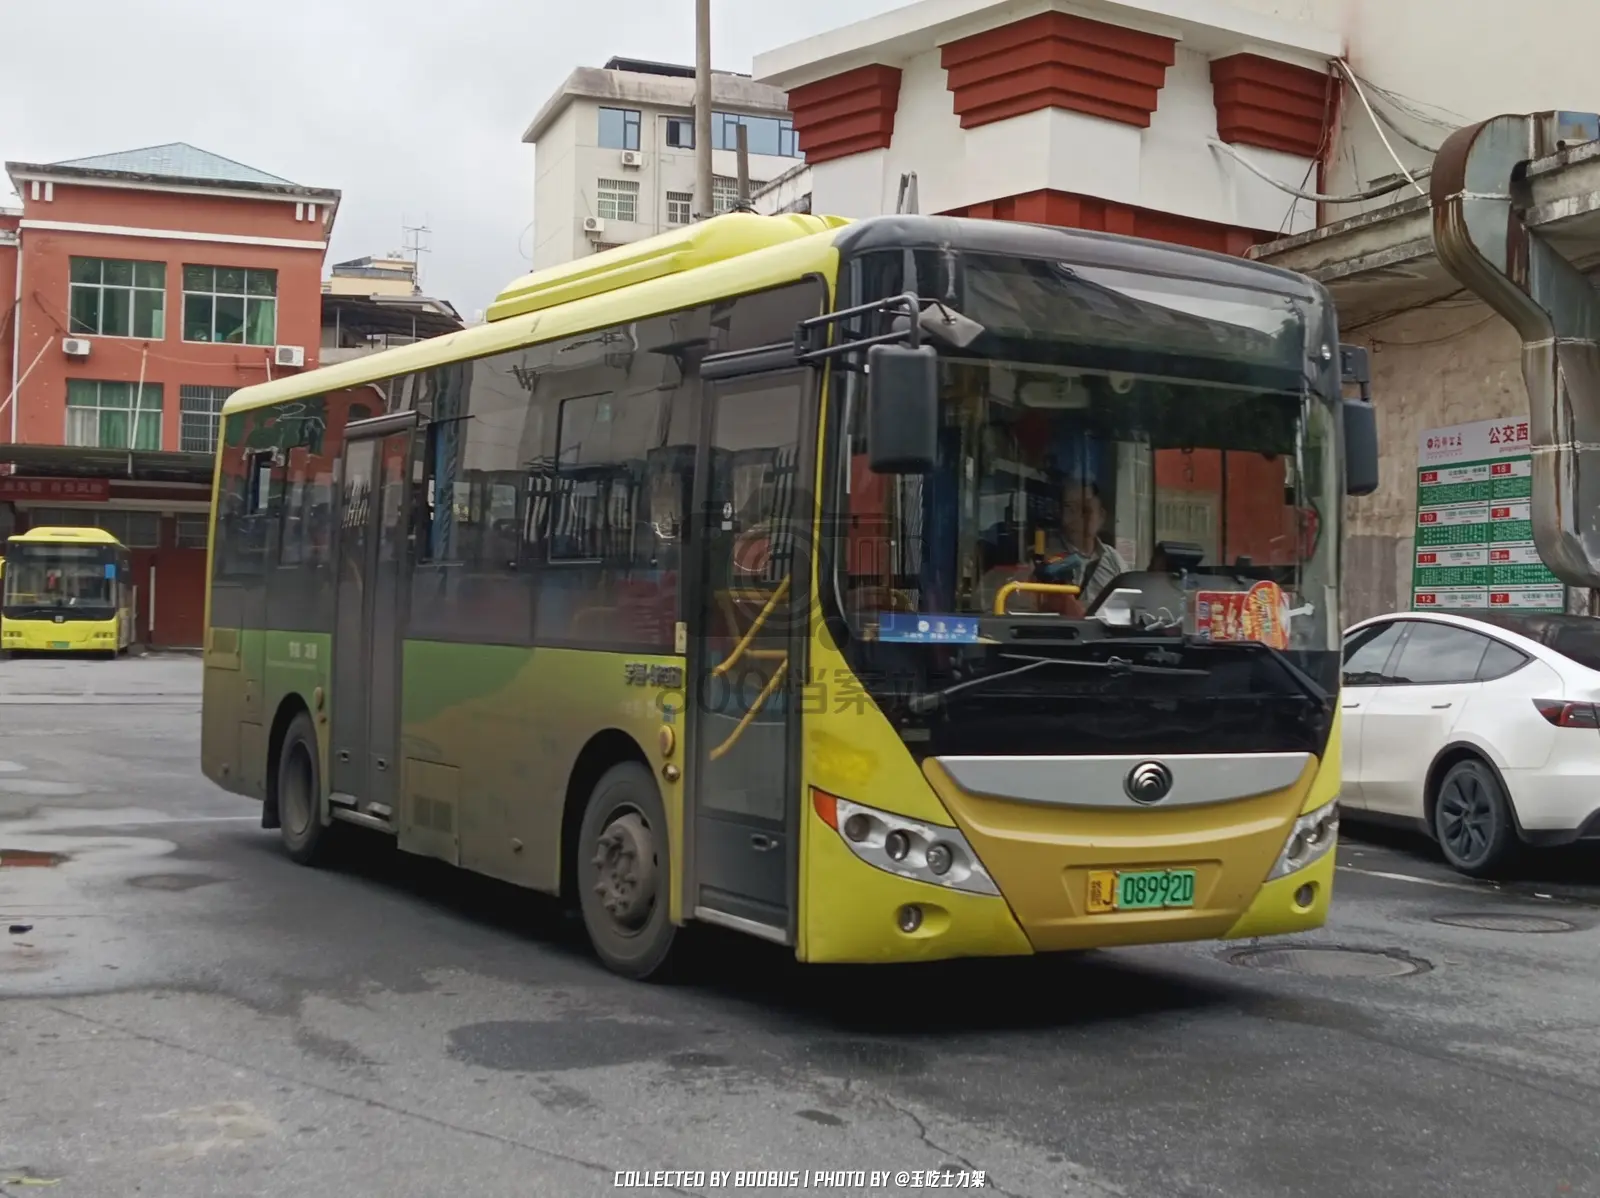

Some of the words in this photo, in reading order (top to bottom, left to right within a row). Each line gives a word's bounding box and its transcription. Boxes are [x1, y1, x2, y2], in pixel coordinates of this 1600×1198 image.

[1488, 422, 1529, 444] 公交西
[1123, 873, 1194, 905] 08992D
